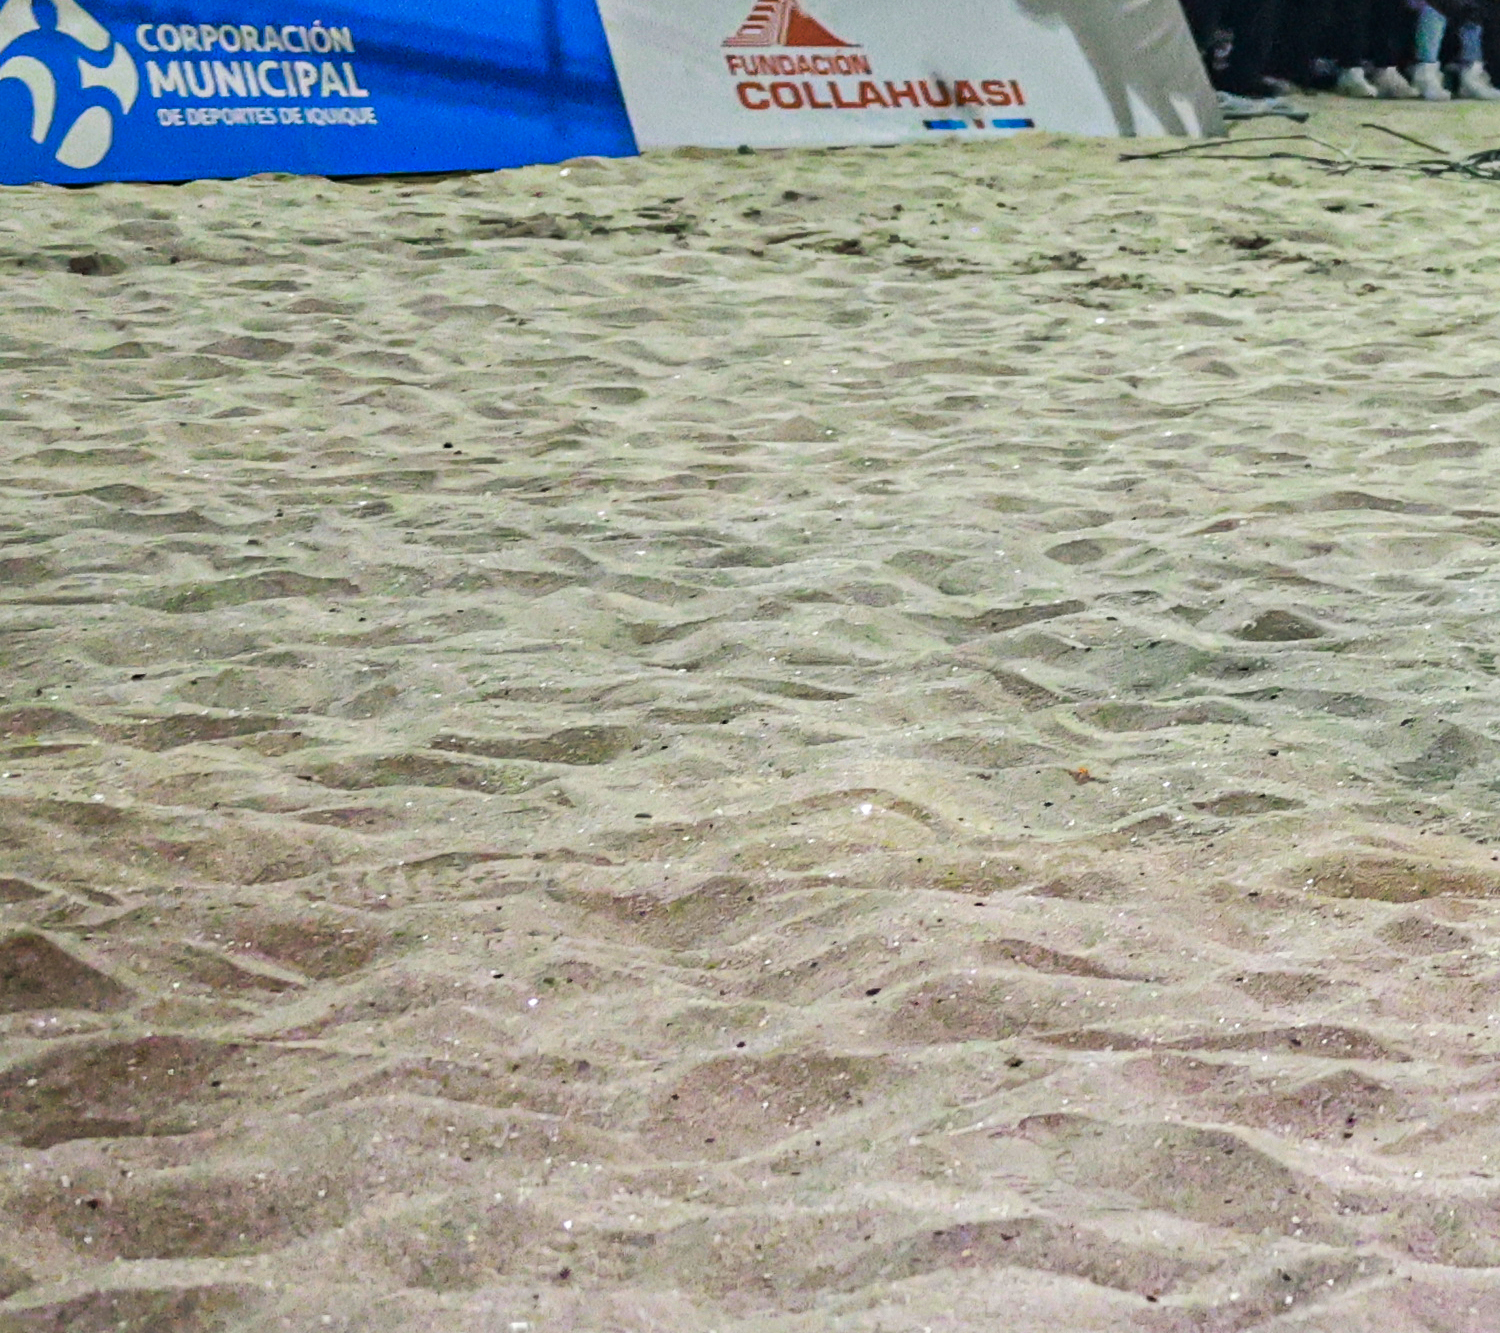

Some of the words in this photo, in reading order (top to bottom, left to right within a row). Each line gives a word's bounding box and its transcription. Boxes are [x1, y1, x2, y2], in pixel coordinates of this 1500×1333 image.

[136, 19, 356, 54] CORPORACIÓN
[725, 49, 873, 76] FUNDACIÓN
[146, 59, 370, 99] MUNICIPAL
[735, 79, 1027, 111] COLLAHUASI
[156, 108, 186, 126] DE
[189, 106, 277, 126] DEPORTES
[279, 106, 304, 125] DE
[306, 106, 378, 126] IQUIQUE
